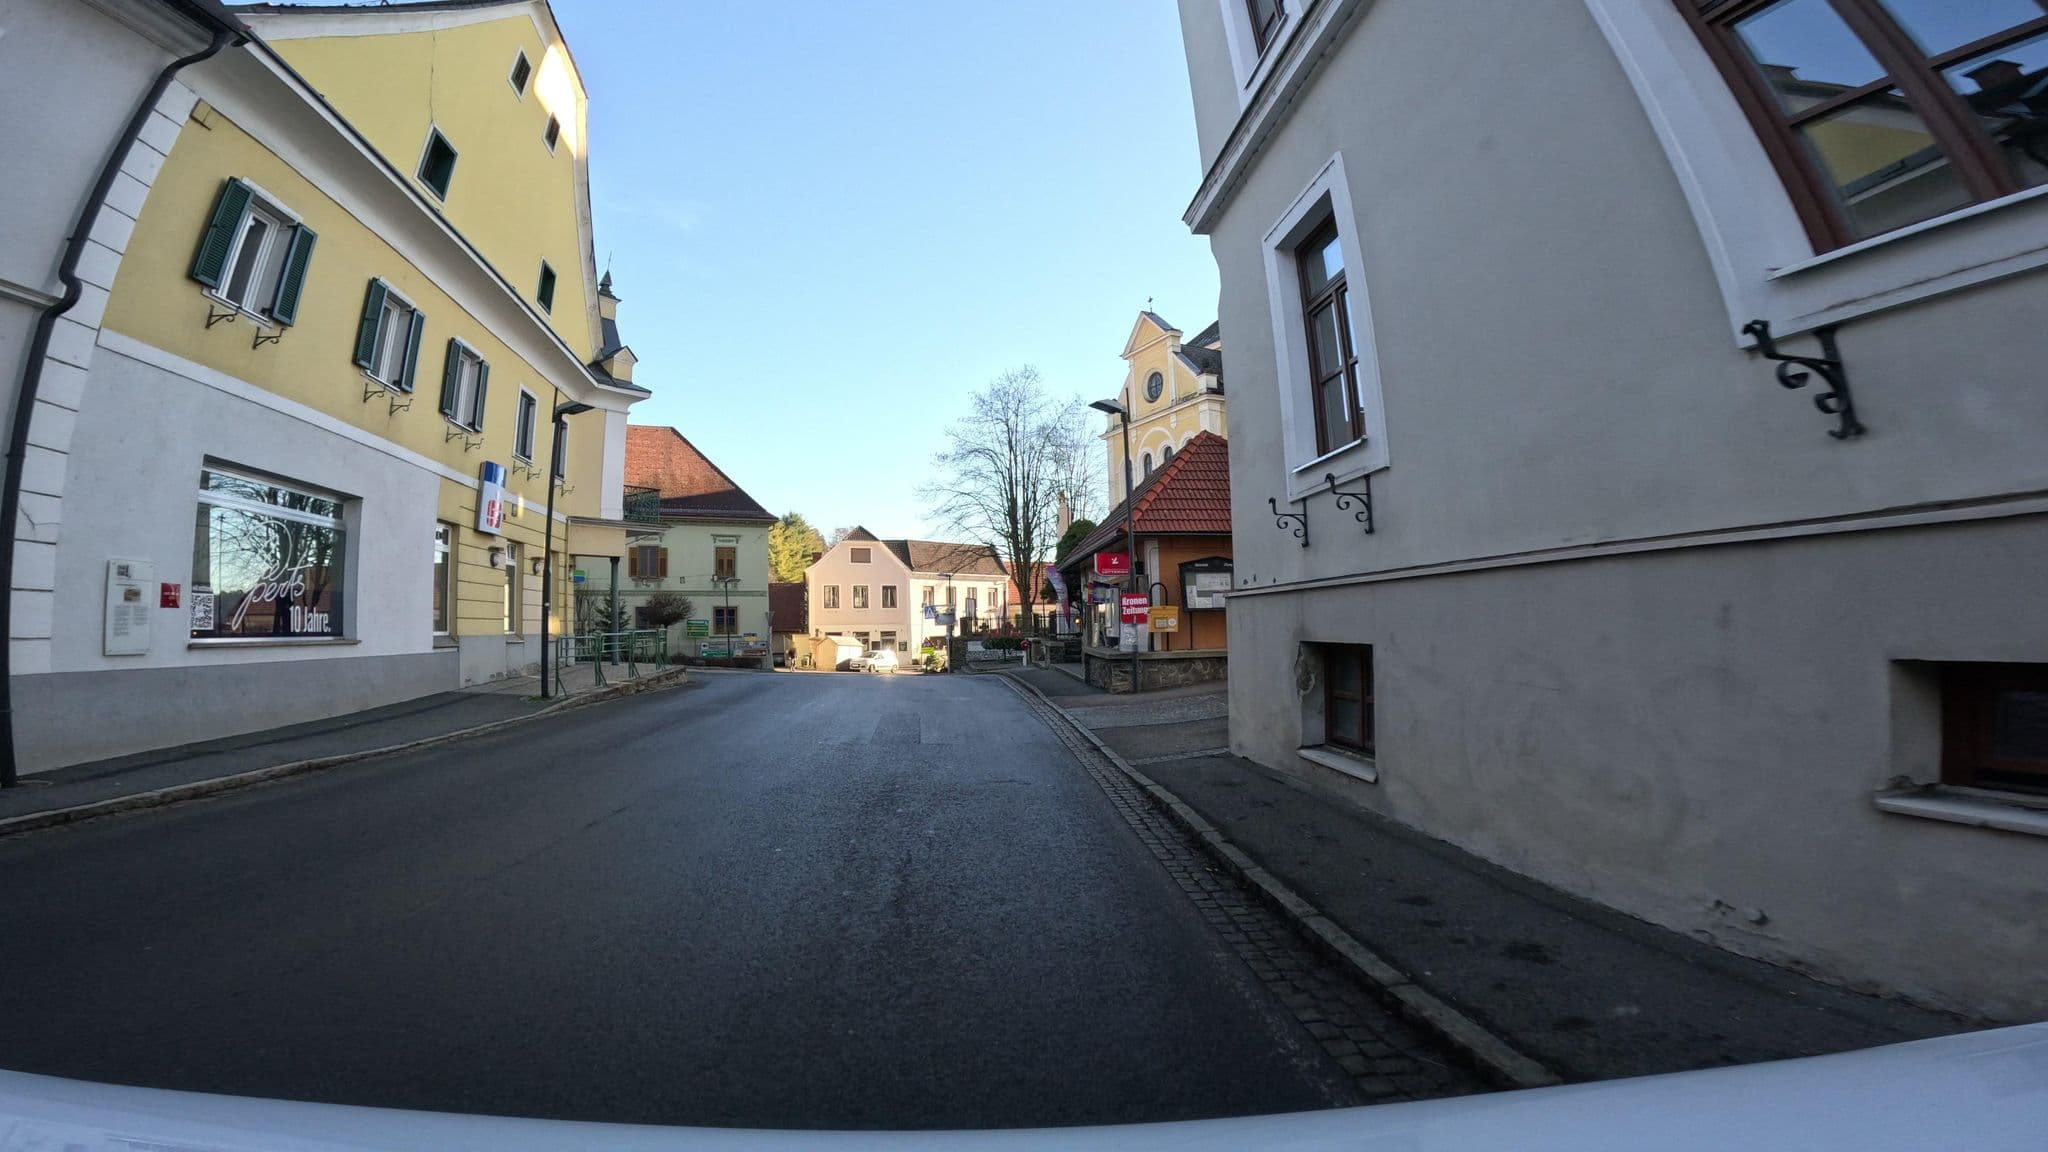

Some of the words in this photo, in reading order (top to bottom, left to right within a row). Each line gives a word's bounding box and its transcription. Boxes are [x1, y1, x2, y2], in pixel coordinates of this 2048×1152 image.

[1121, 597, 1147, 606] Kronen
[1122, 606, 1148, 615] Zeitung
[289, 605, 301, 633] 10
